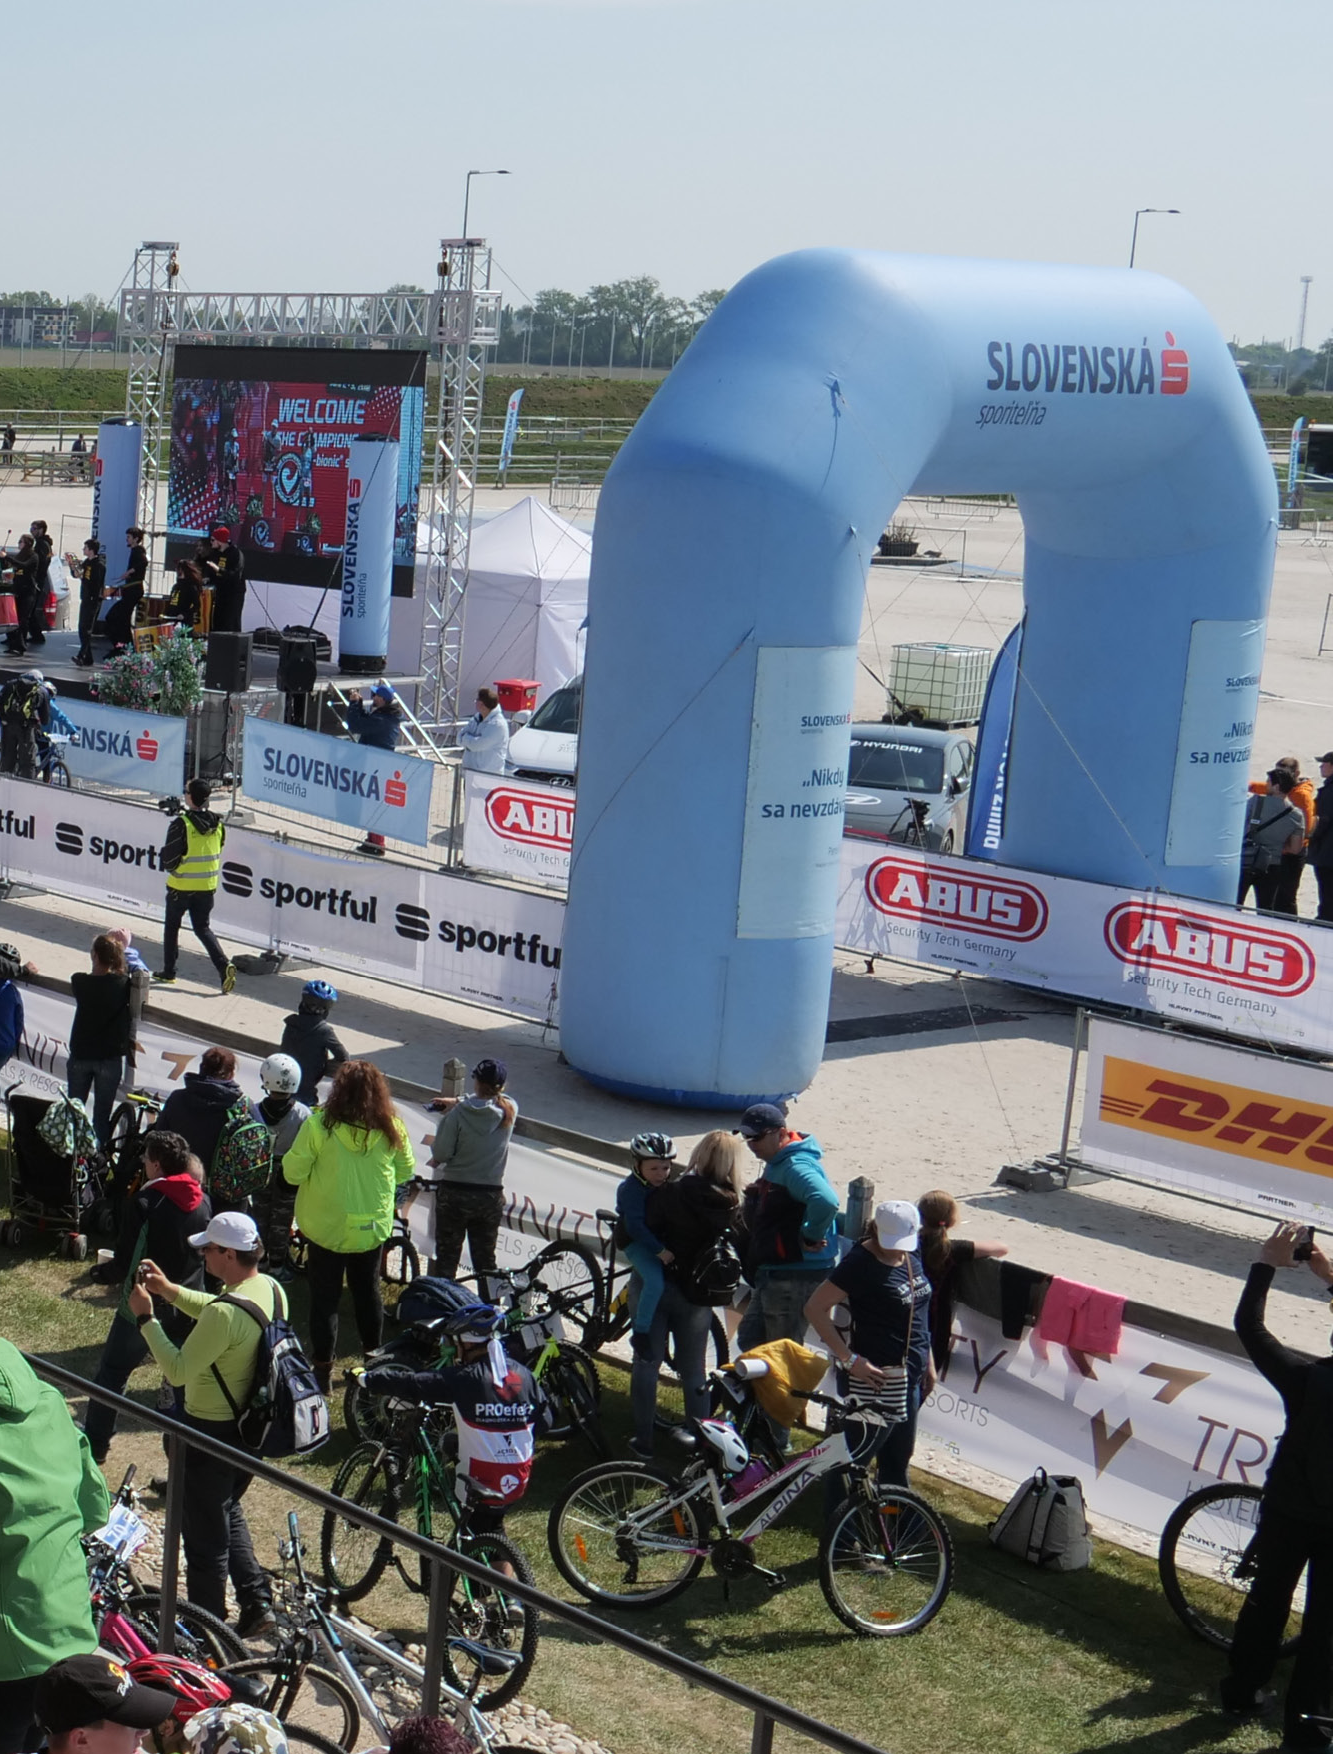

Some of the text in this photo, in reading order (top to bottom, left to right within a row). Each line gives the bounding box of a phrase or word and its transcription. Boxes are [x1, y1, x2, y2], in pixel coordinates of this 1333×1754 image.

[987, 336, 1154, 394] SLOVENSKÁ
[278, 398, 367, 425] WELCOME
[975, 400, 1047, 430] sporiteľňa
[863, 740, 923, 754] HYUNDAI
[1190, 751, 1209, 764] sa
[262, 775, 308, 798] sporiteľňa
[263, 747, 380, 802] SLOVENSKÁ
[761, 803, 785, 818] sa
[89, 835, 166, 872] sportf
[503, 844, 538, 863] Security
[540, 853, 560, 865] Tech
[259, 877, 377, 924] sportful
[888, 872, 1023, 928] ABUS
[438, 919, 563, 970] sportfu
[886, 921, 1017, 962] Security Tech Germany
[1131, 918, 1286, 981] ABUS
[1127, 971, 1277, 1017] Security Tech Germany
[760, 1471, 815, 1530] ALPINA
